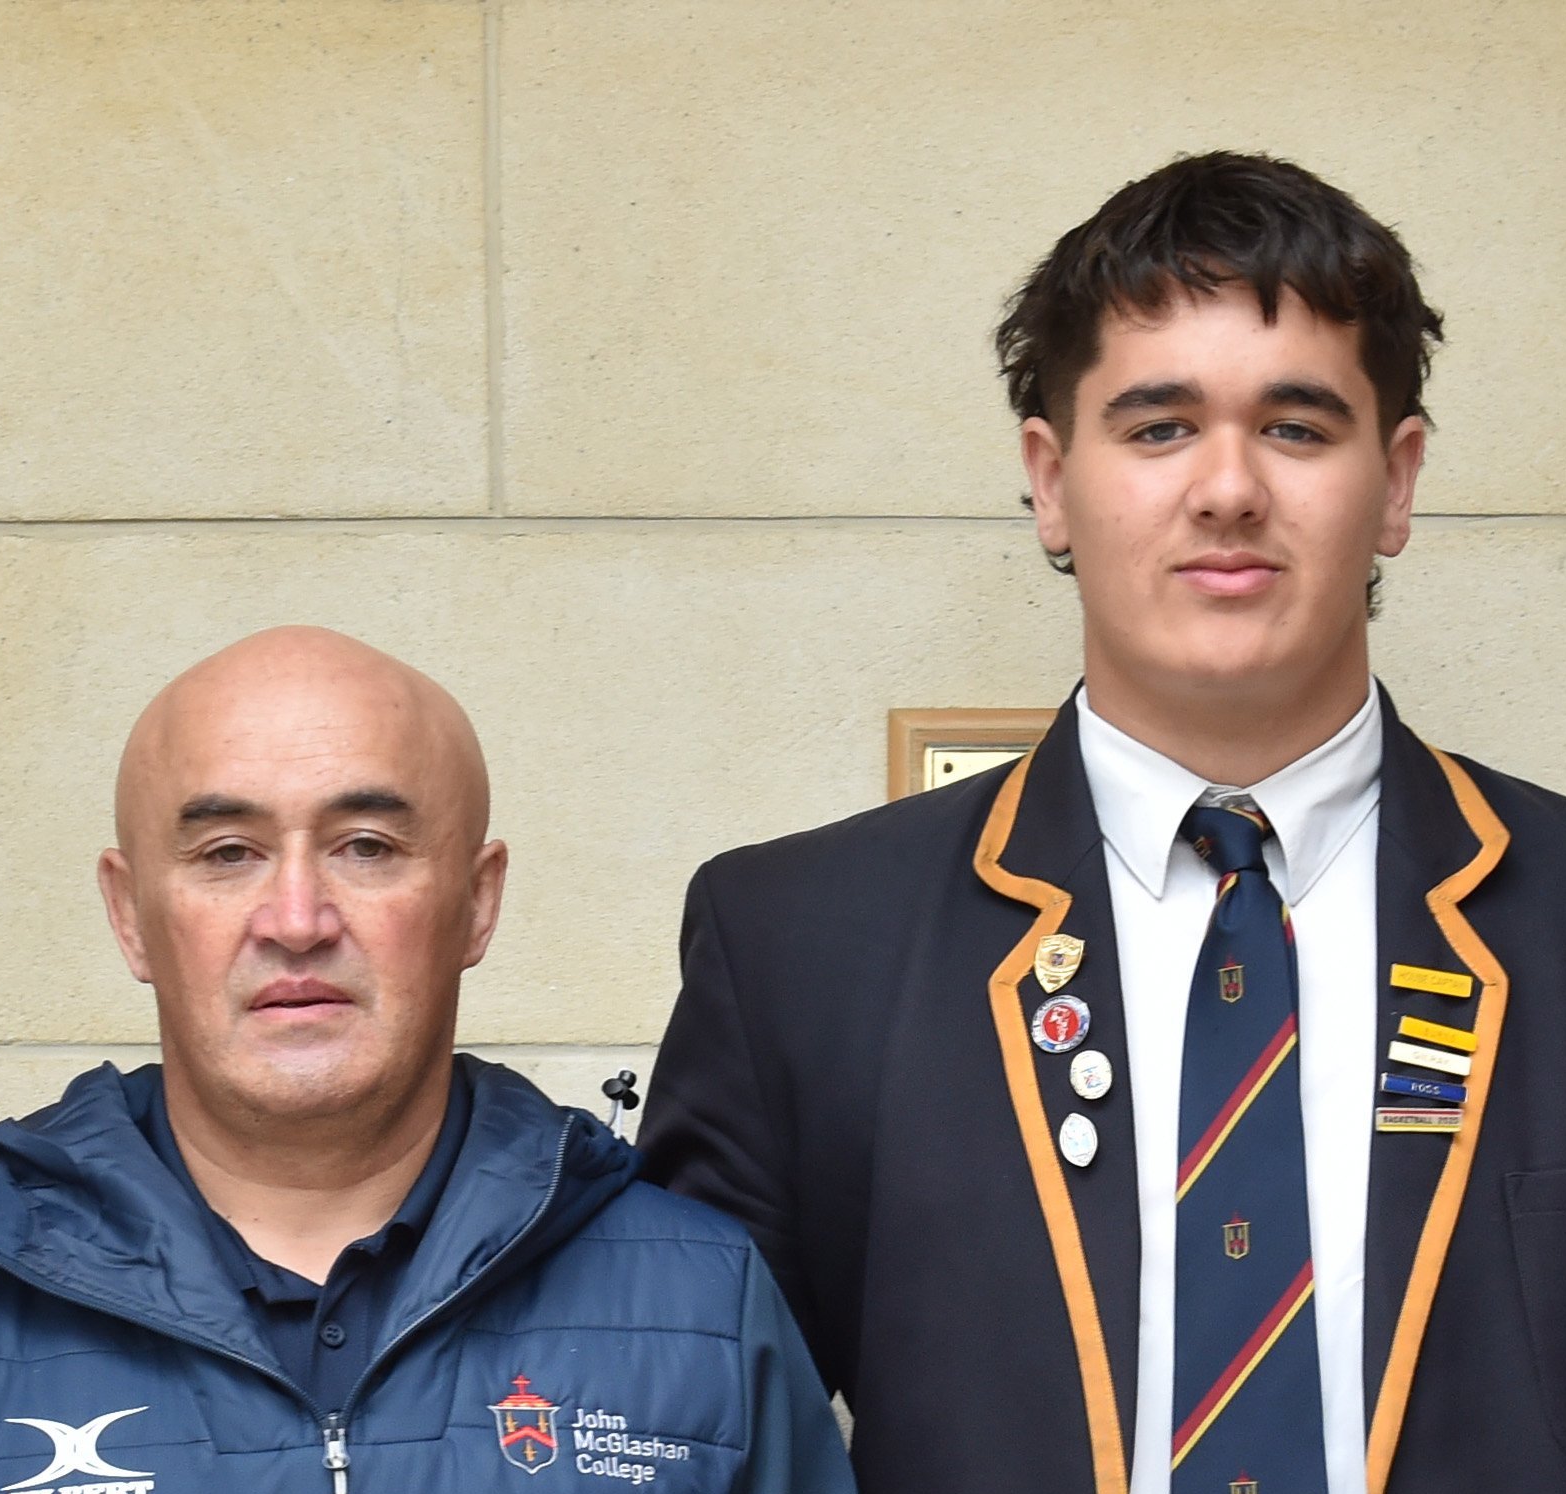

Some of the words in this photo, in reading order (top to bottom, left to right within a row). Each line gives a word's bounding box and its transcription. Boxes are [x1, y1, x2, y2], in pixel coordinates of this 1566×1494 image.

[1411, 1082, 1441, 1095] ROSS
[1382, 1115, 1433, 1125] BASKETBALL
[571, 1408, 628, 1430] John
[573, 1429, 690, 1461] McGlashan
[576, 1453, 656, 1485] College
